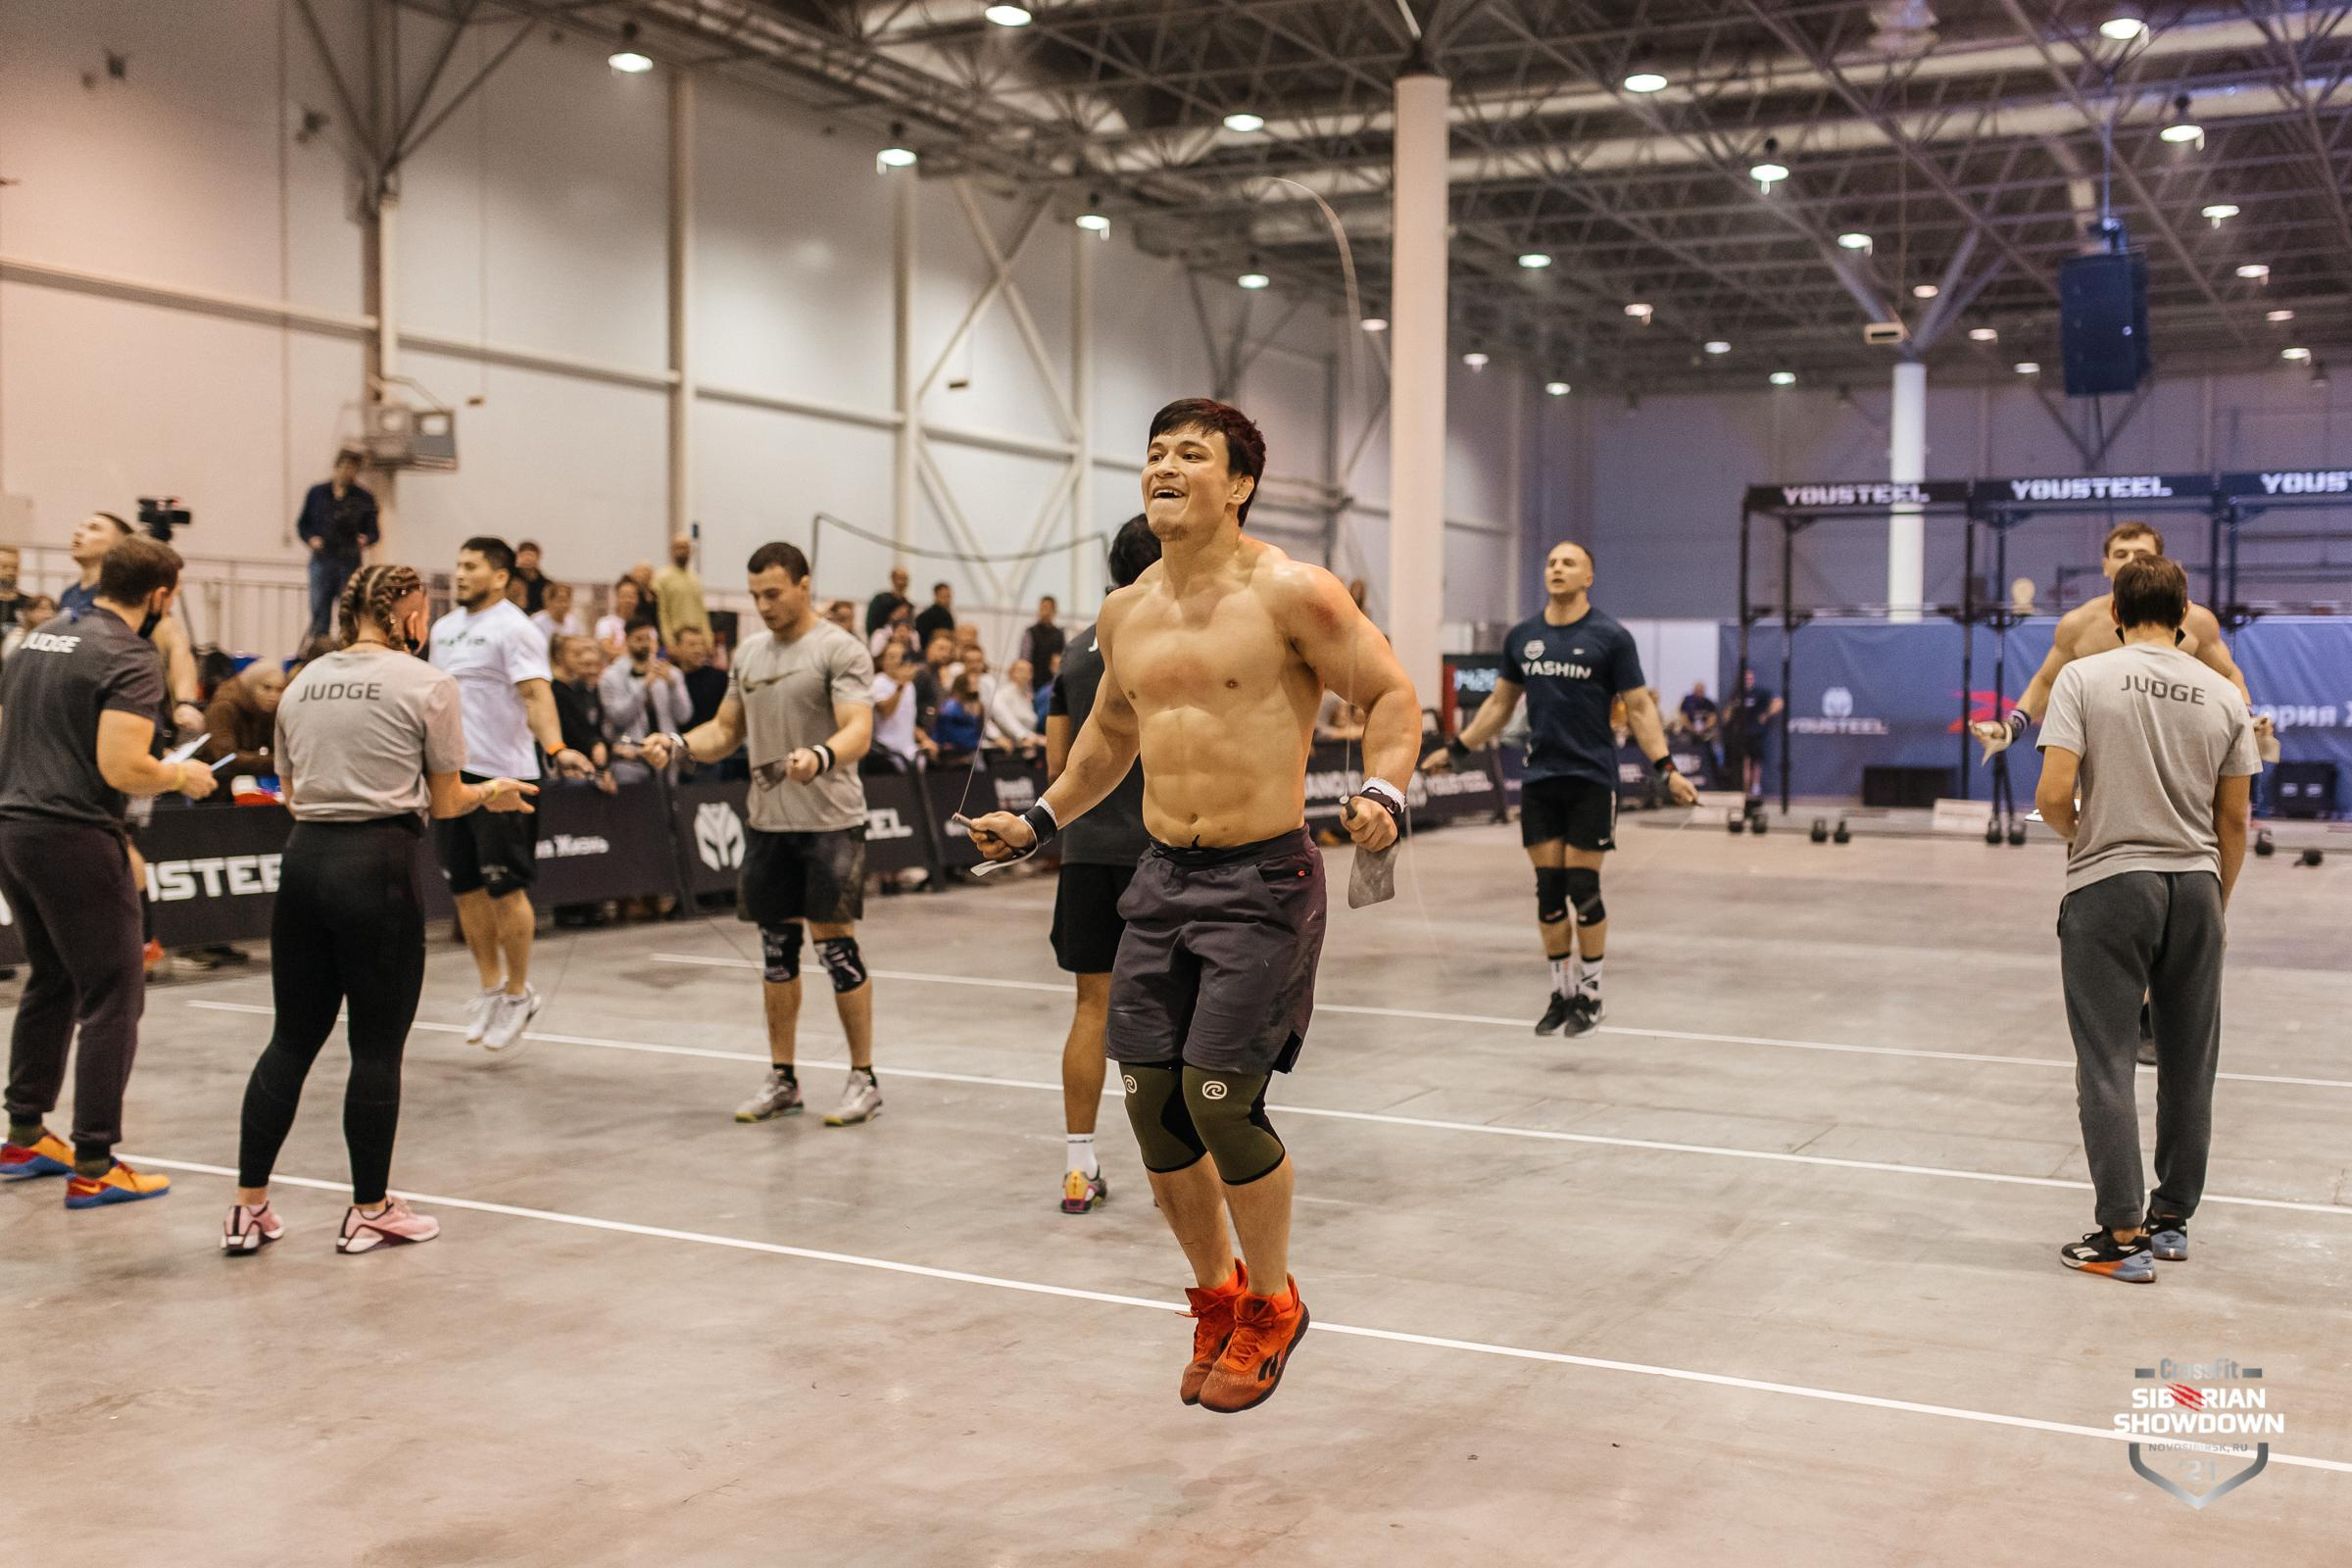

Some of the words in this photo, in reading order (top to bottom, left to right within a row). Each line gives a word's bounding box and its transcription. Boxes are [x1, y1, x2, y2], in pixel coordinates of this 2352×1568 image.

[2011, 475, 2173, 501] YOUSTEEL
[2260, 471, 2352, 494] YOUS
[1783, 484, 1931, 506] YOUSTEEL
[21, 632, 81, 653] JUDGE
[1521, 661, 1592, 679] YASHIN
[298, 682, 382, 703] JUDGE
[2120, 674, 2206, 706] JUDGE
